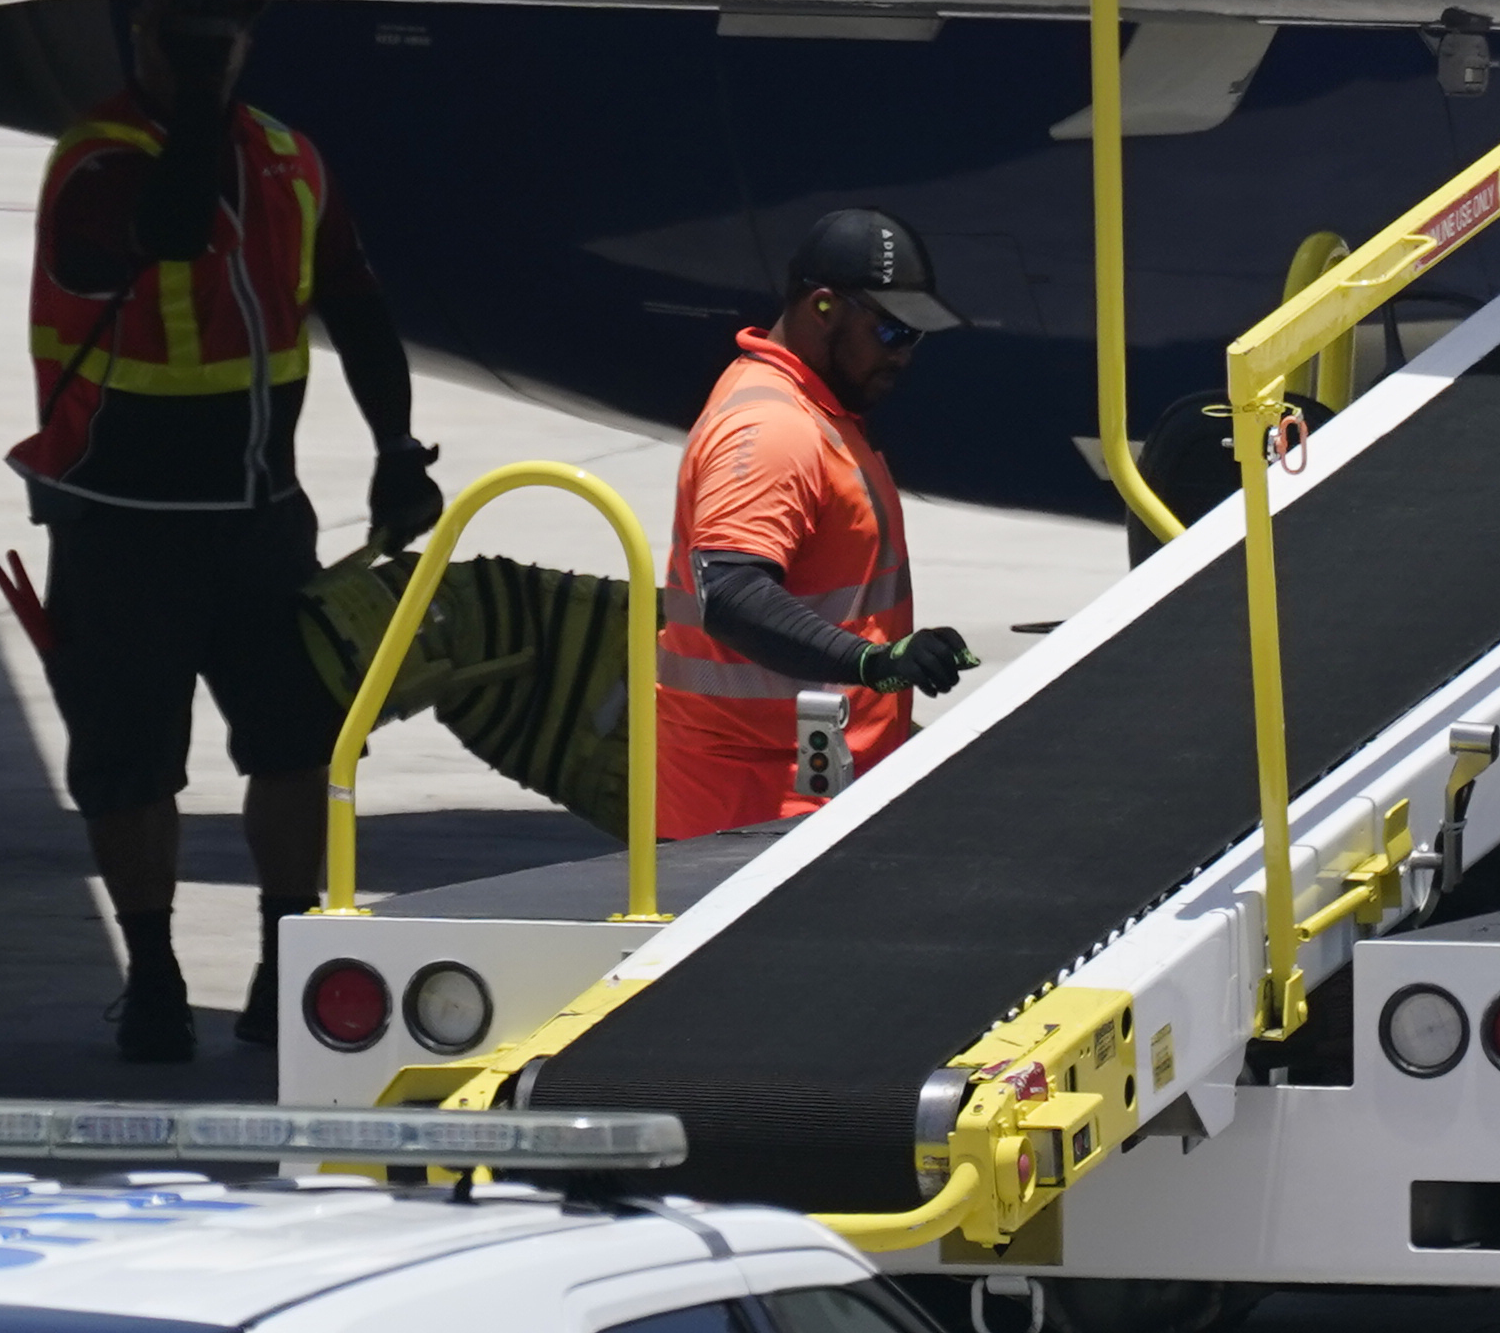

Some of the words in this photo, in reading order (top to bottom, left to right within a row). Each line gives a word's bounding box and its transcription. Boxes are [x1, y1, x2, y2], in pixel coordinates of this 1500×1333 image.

[1455, 199, 1473, 231] USE
[1473, 183, 1495, 218] ONLY
[883, 241, 895, 284] DELTA
